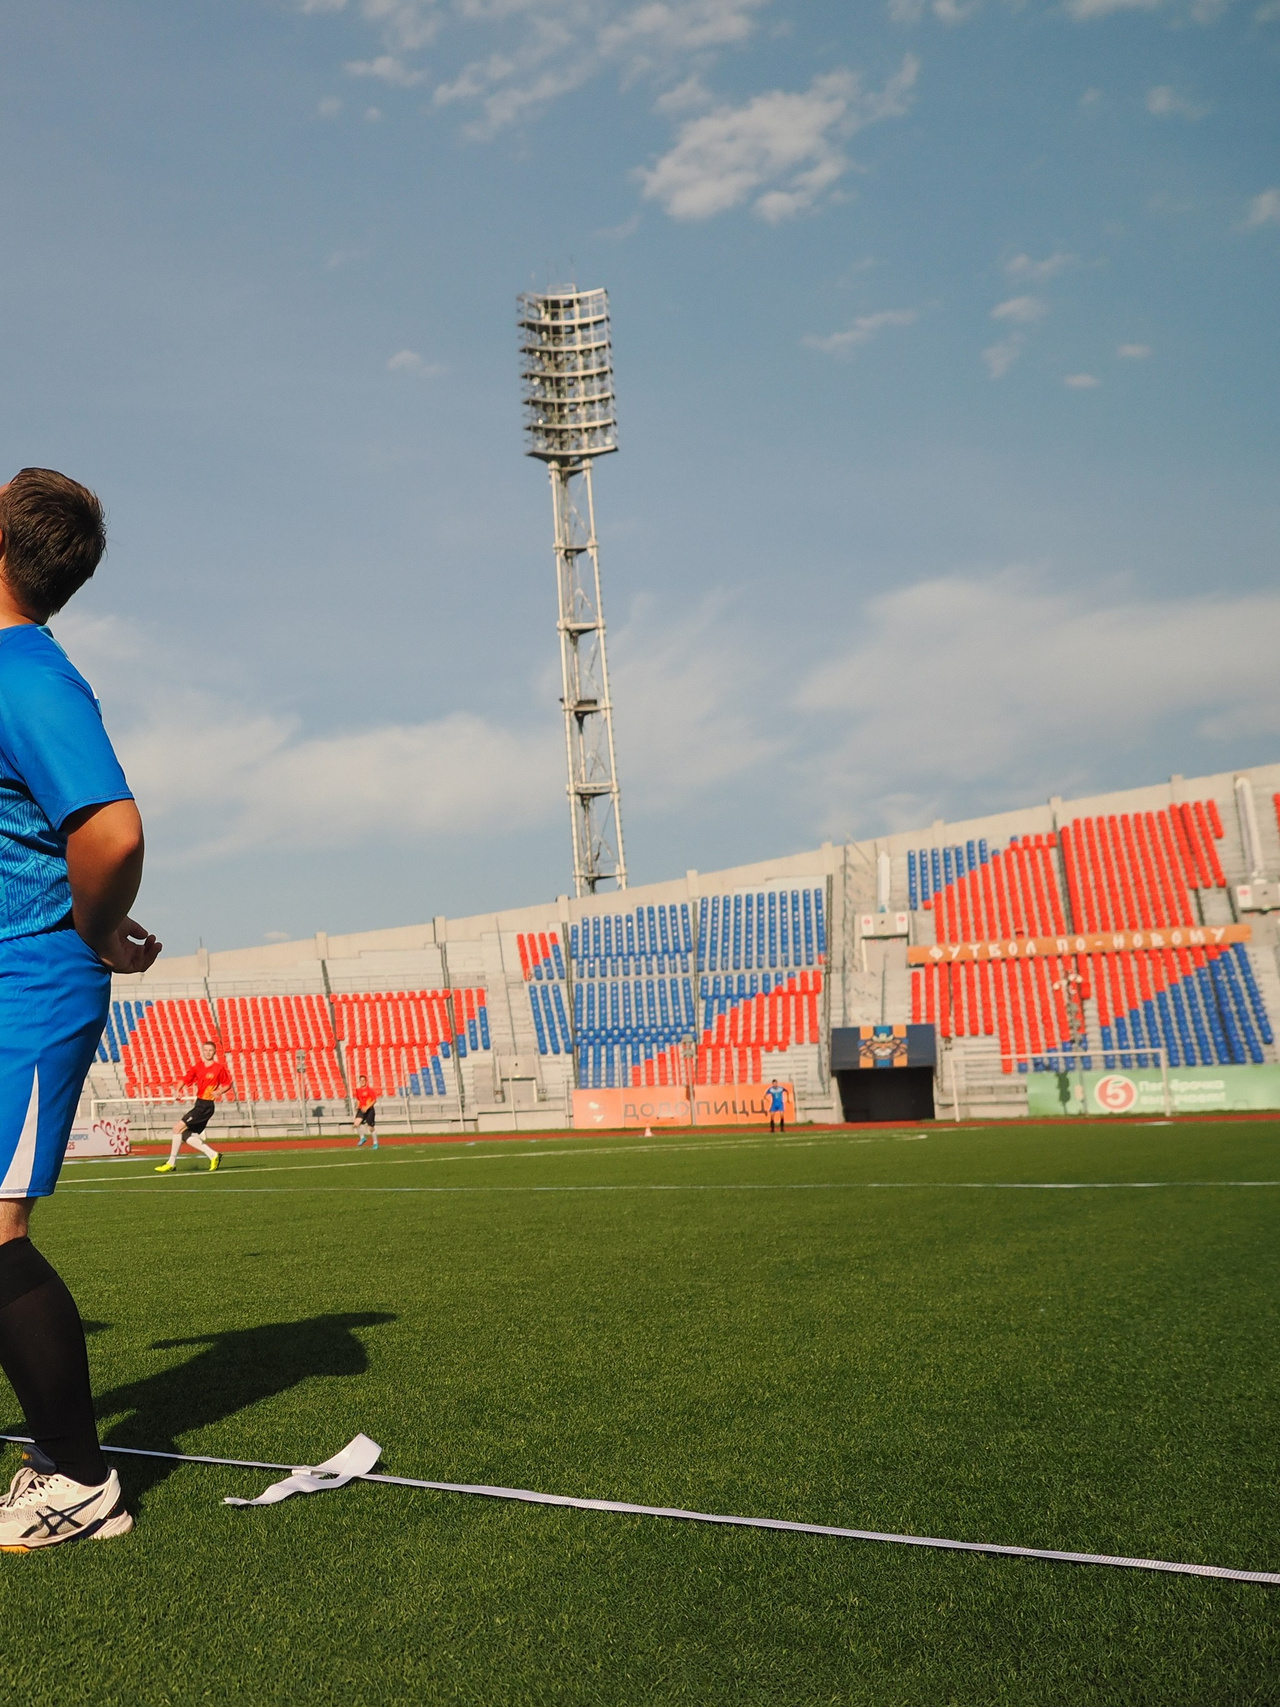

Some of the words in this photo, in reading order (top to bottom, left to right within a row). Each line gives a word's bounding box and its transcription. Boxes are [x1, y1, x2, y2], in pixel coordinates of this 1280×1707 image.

[929, 941, 1036, 959] ФУТБОЛ
[624, 1102, 690, 1120] ДОДО
[696, 1099, 769, 1116] ПИЦЦ
